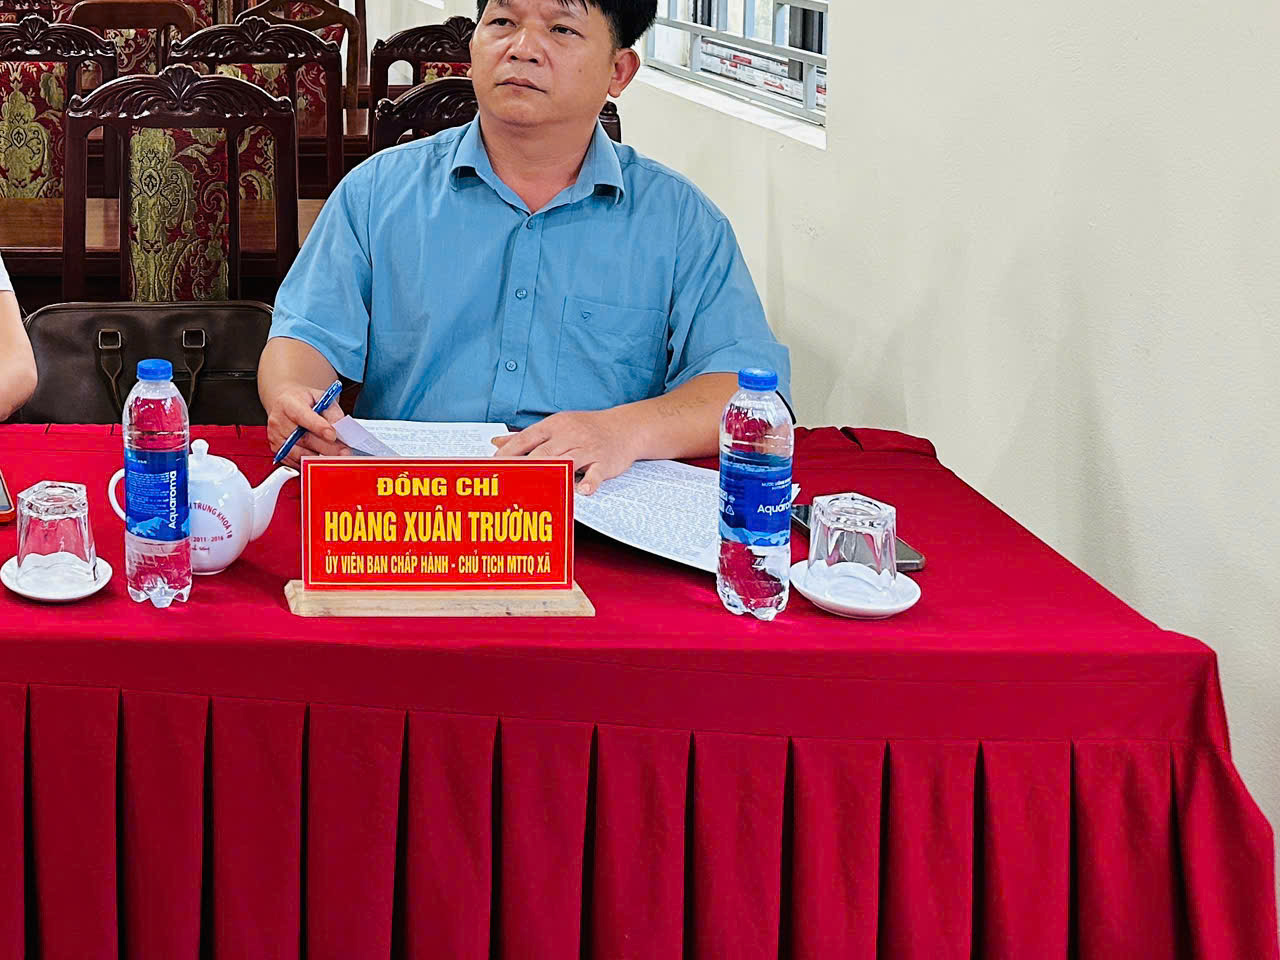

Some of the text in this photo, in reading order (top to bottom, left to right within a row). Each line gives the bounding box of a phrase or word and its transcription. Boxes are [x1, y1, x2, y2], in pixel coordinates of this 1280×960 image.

[168, 470, 179, 529] Aquaroma
[376, 471, 499, 497] ĐỒNG CHÍ
[324, 504, 553, 543] HOÀNG XUÂN TRƯỜNG
[325, 549, 338, 573] ỦY
[341, 552, 364, 573] VIÊN
[367, 555, 388, 573] BAN
[391, 549, 418, 573] CHẤP
[420, 552, 449, 573] HÀNH
[458, 549, 478, 573] CHỦ
[481, 555, 504, 577] TỊCH
[507, 555, 534, 575] MTTQ
[537, 552, 551, 573] XÃ
